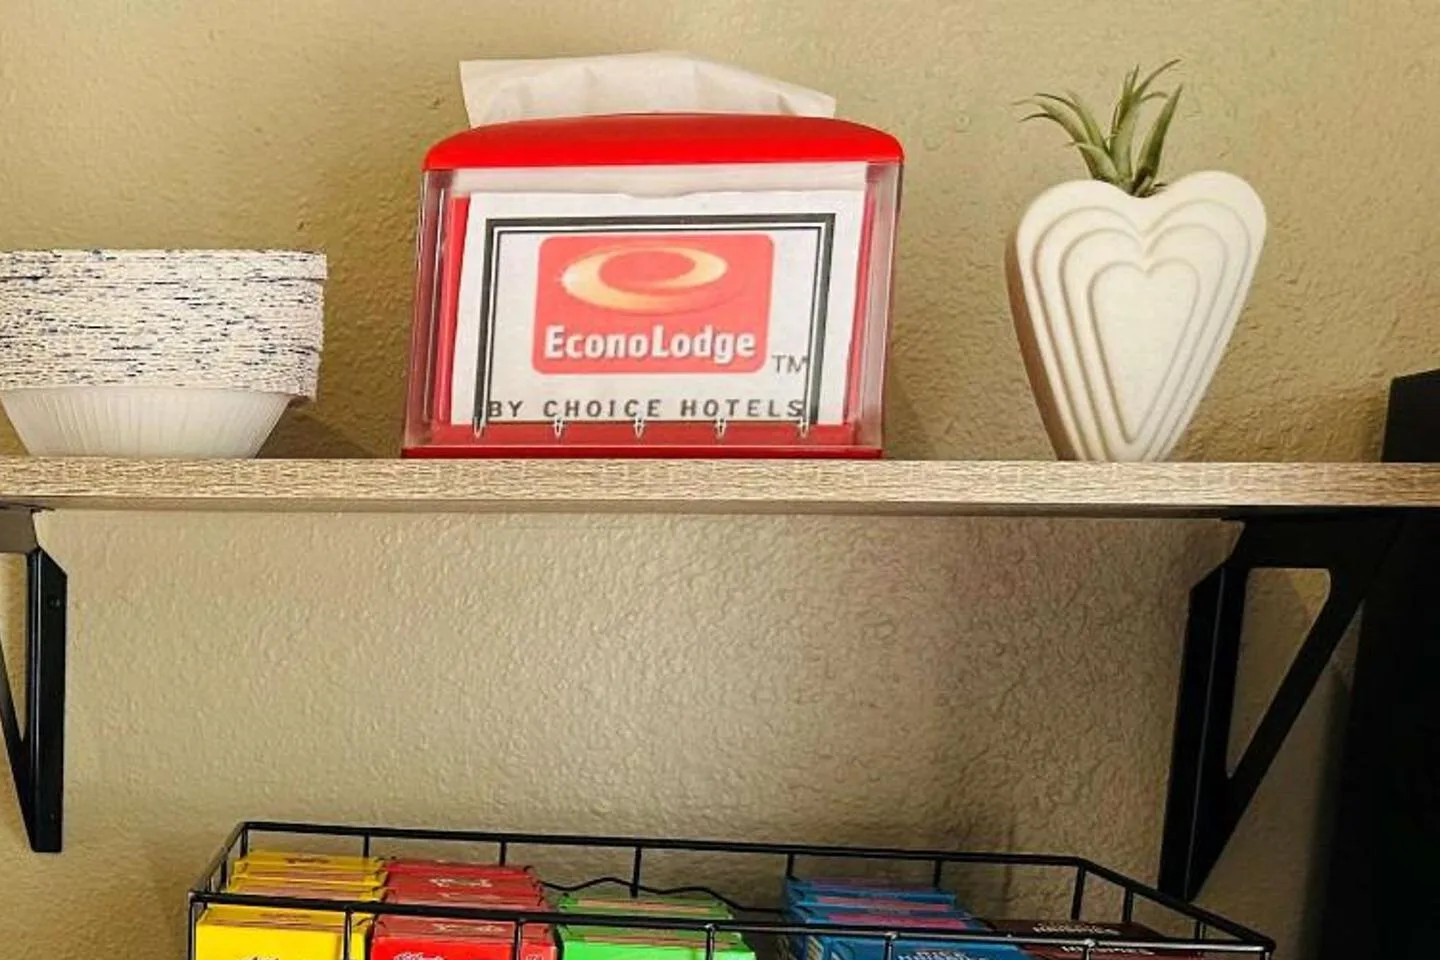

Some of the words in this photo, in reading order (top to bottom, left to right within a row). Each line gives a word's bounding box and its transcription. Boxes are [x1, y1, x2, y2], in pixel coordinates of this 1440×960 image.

[543, 325, 757, 364] EconoLodge
[487, 400, 524, 418] BY
[543, 400, 662, 418] CHOICE
[680, 399, 805, 418] HOTELS
